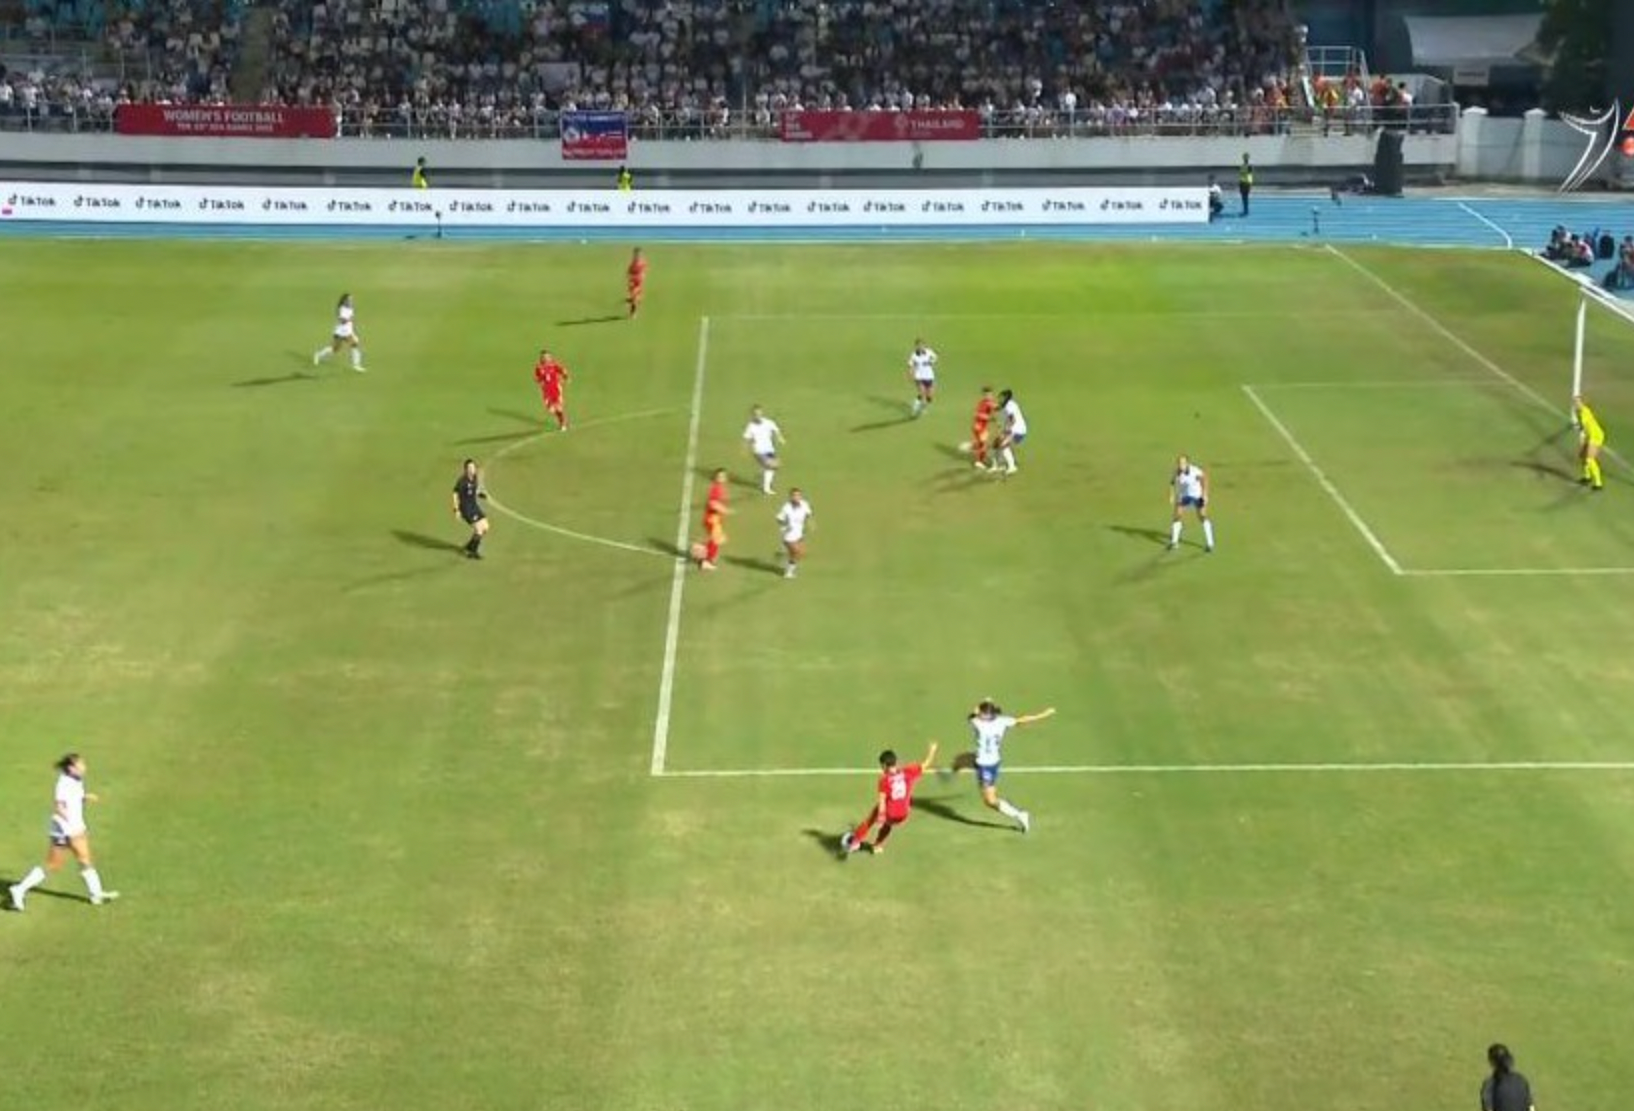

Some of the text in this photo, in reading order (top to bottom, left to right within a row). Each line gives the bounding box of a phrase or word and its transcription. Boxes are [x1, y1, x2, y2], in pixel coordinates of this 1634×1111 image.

[163, 109, 283, 123] WOMEN'S FOOTBALL
[910, 119, 965, 130] THAILAND
[20, 196, 56, 206] TikTok
[86, 197, 120, 207] TikTok
[147, 199, 181, 209] TikTok
[210, 200, 244, 210] TikTok
[274, 201, 308, 210] TikTok
[1052, 201, 1085, 210] TikTok
[1111, 201, 1143, 210] TikTok
[1171, 200, 1202, 209] TikTok
[338, 201, 372, 211] TikTok
[399, 202, 433, 211] TikTok
[461, 202, 493, 212] TikTok
[518, 203, 550, 212] TikTok
[578, 203, 610, 212] TikTok
[638, 203, 670, 213] TikTok
[700, 204, 732, 213] TikTok
[759, 203, 791, 212] TikTok
[818, 203, 850, 212] TikTok
[874, 202, 905, 212] TikTok
[933, 202, 964, 212] TikTok
[991, 202, 1023, 211] TikTok
